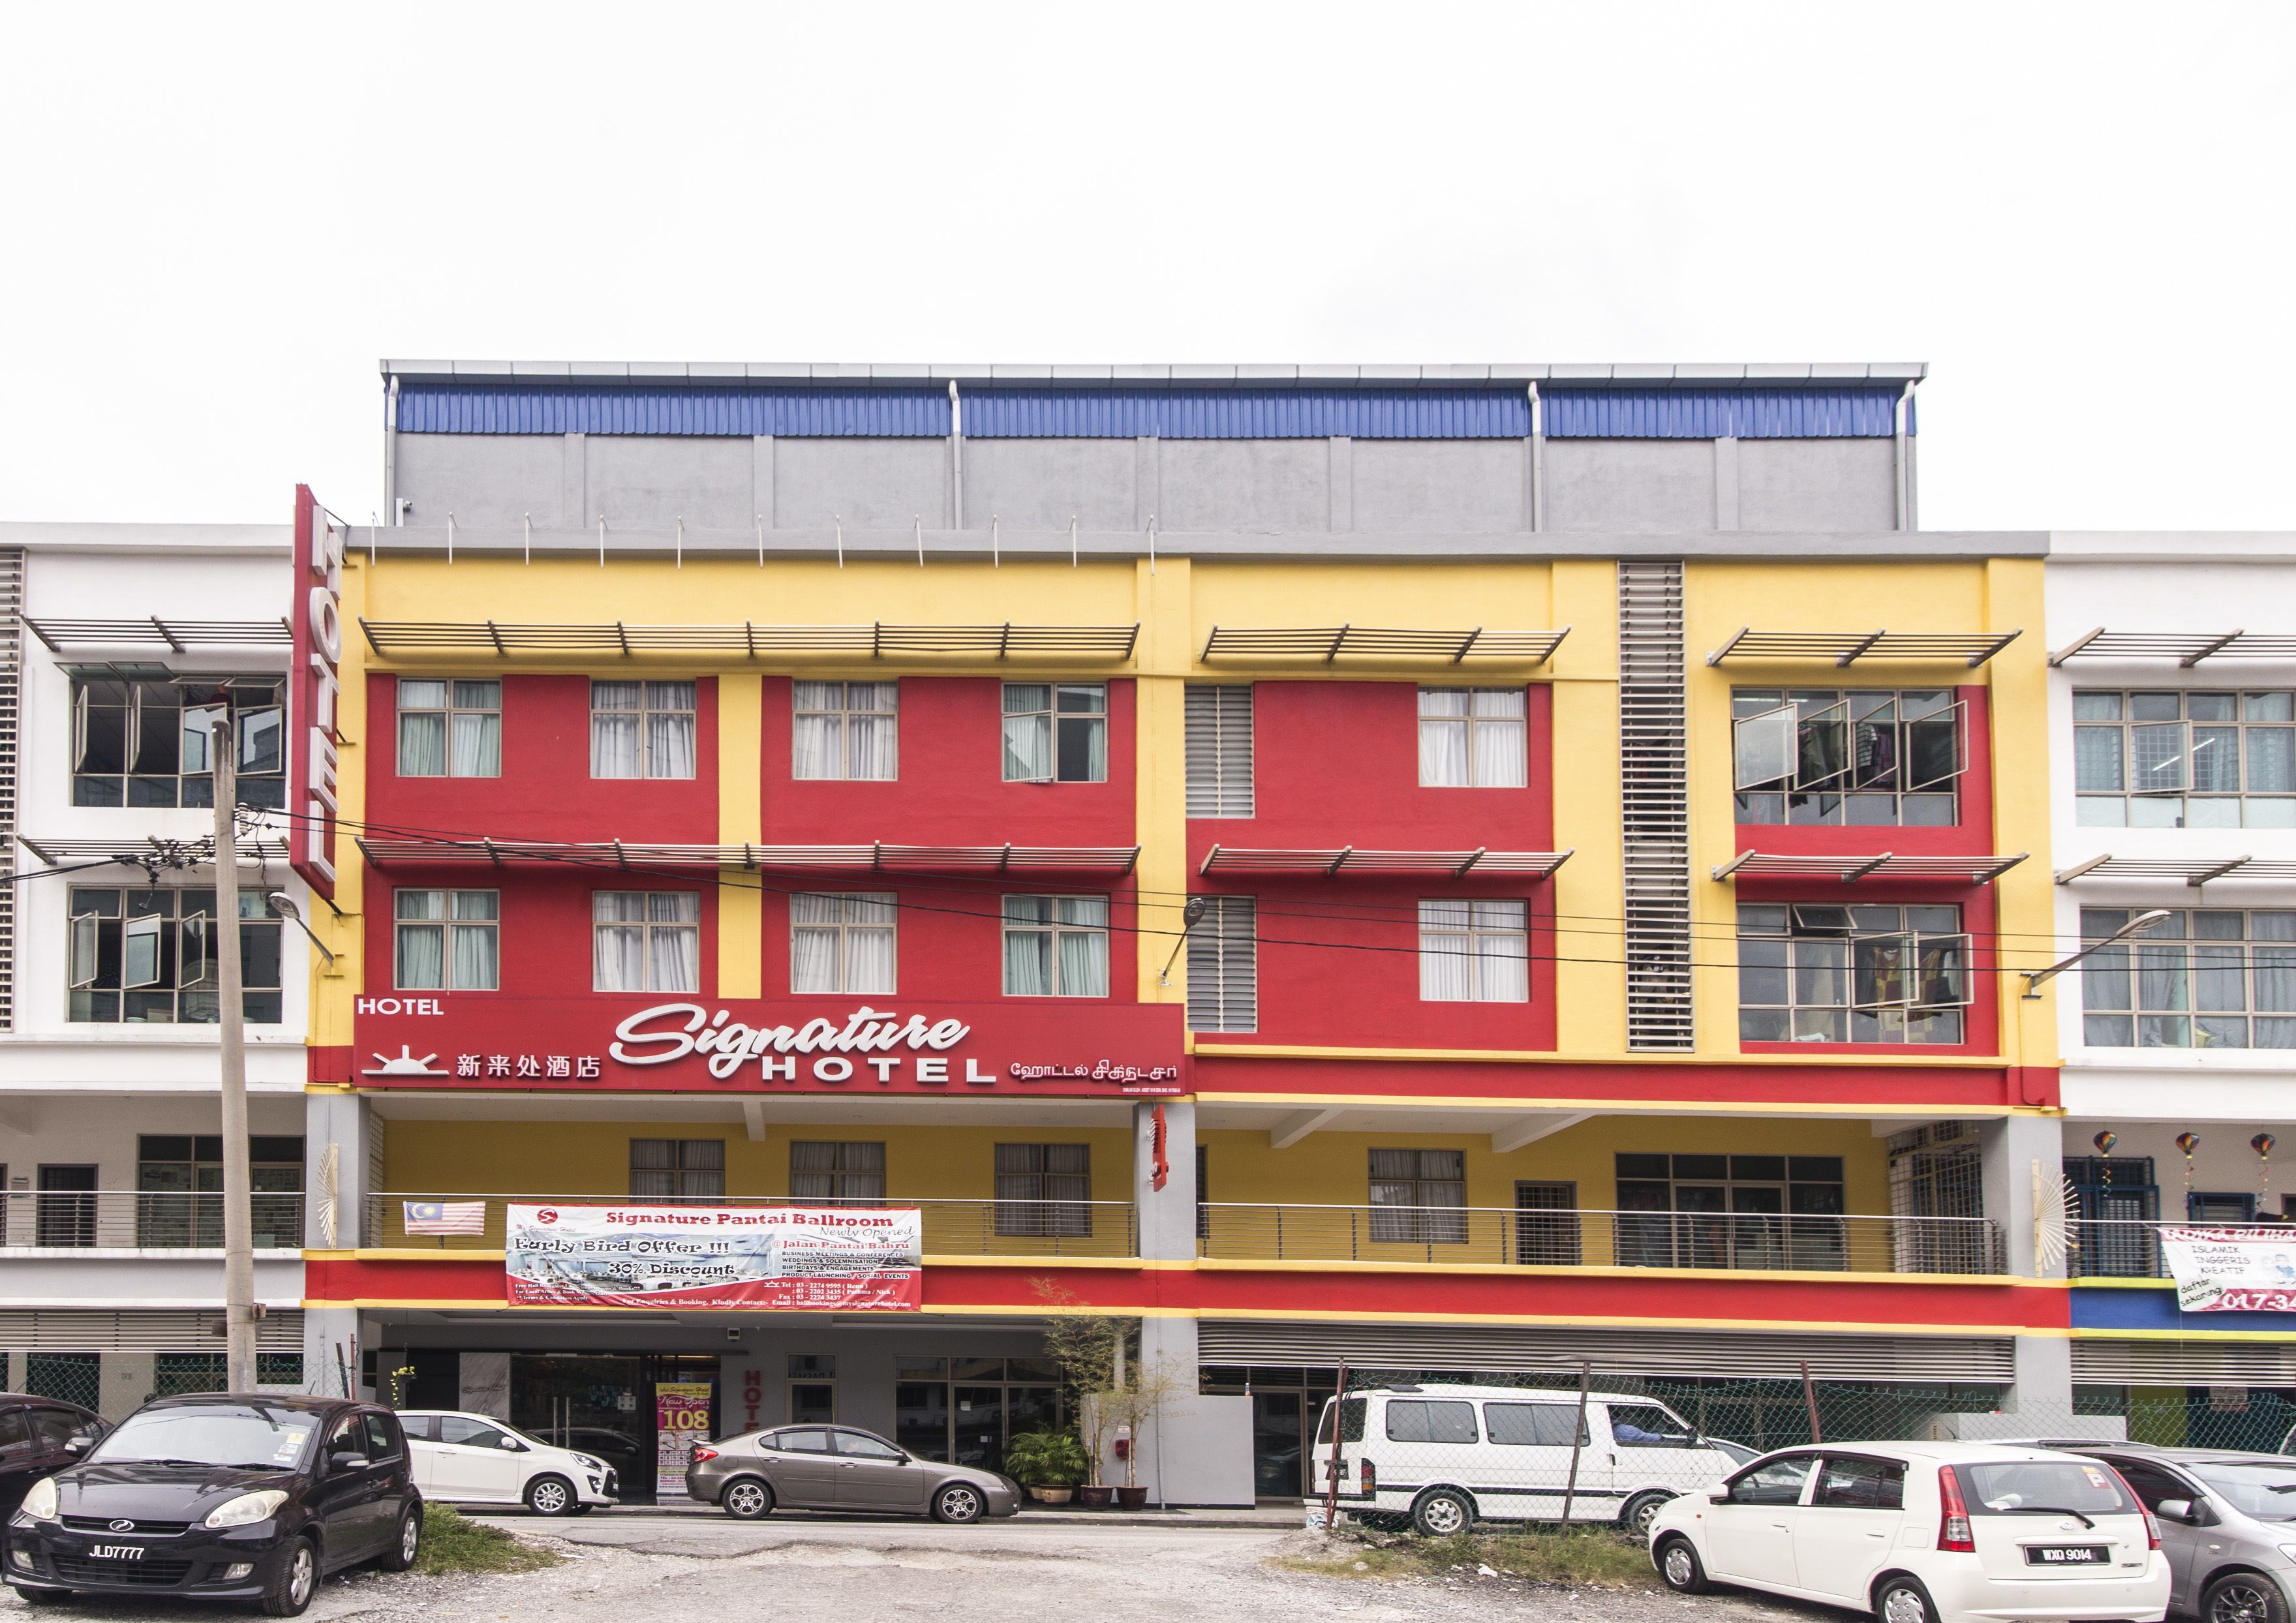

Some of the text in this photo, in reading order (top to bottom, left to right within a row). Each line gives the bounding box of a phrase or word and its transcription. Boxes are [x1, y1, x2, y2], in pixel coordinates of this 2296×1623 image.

[308, 504, 343, 881] HOTEL
[358, 997, 444, 1016] HOTEL
[609, 1003, 970, 1079] Signature
[457, 1054, 602, 1078] 新来处酒店
[762, 1055, 996, 1084] HOTEL
[1011, 1062, 1089, 1082] ஹோட்டல்
[607, 1212, 893, 1227] Signature Pantai Ballroom
[820, 1226, 916, 1239] Newly Opened
[514, 1238, 729, 1253] Early Bird Offer !!!
[784, 1240, 818, 1249] Jalan
[821, 1241, 865, 1249] Pantai
[609, 1262, 735, 1275] 30% Discount
[2181, 1279, 2211, 1294] daftar
[684, 1398, 710, 1408] Open
[664, 1410, 710, 1430] 108
[89, 1545, 144, 1560] JLD7777
[2066, 1549, 2092, 1560] 9014
